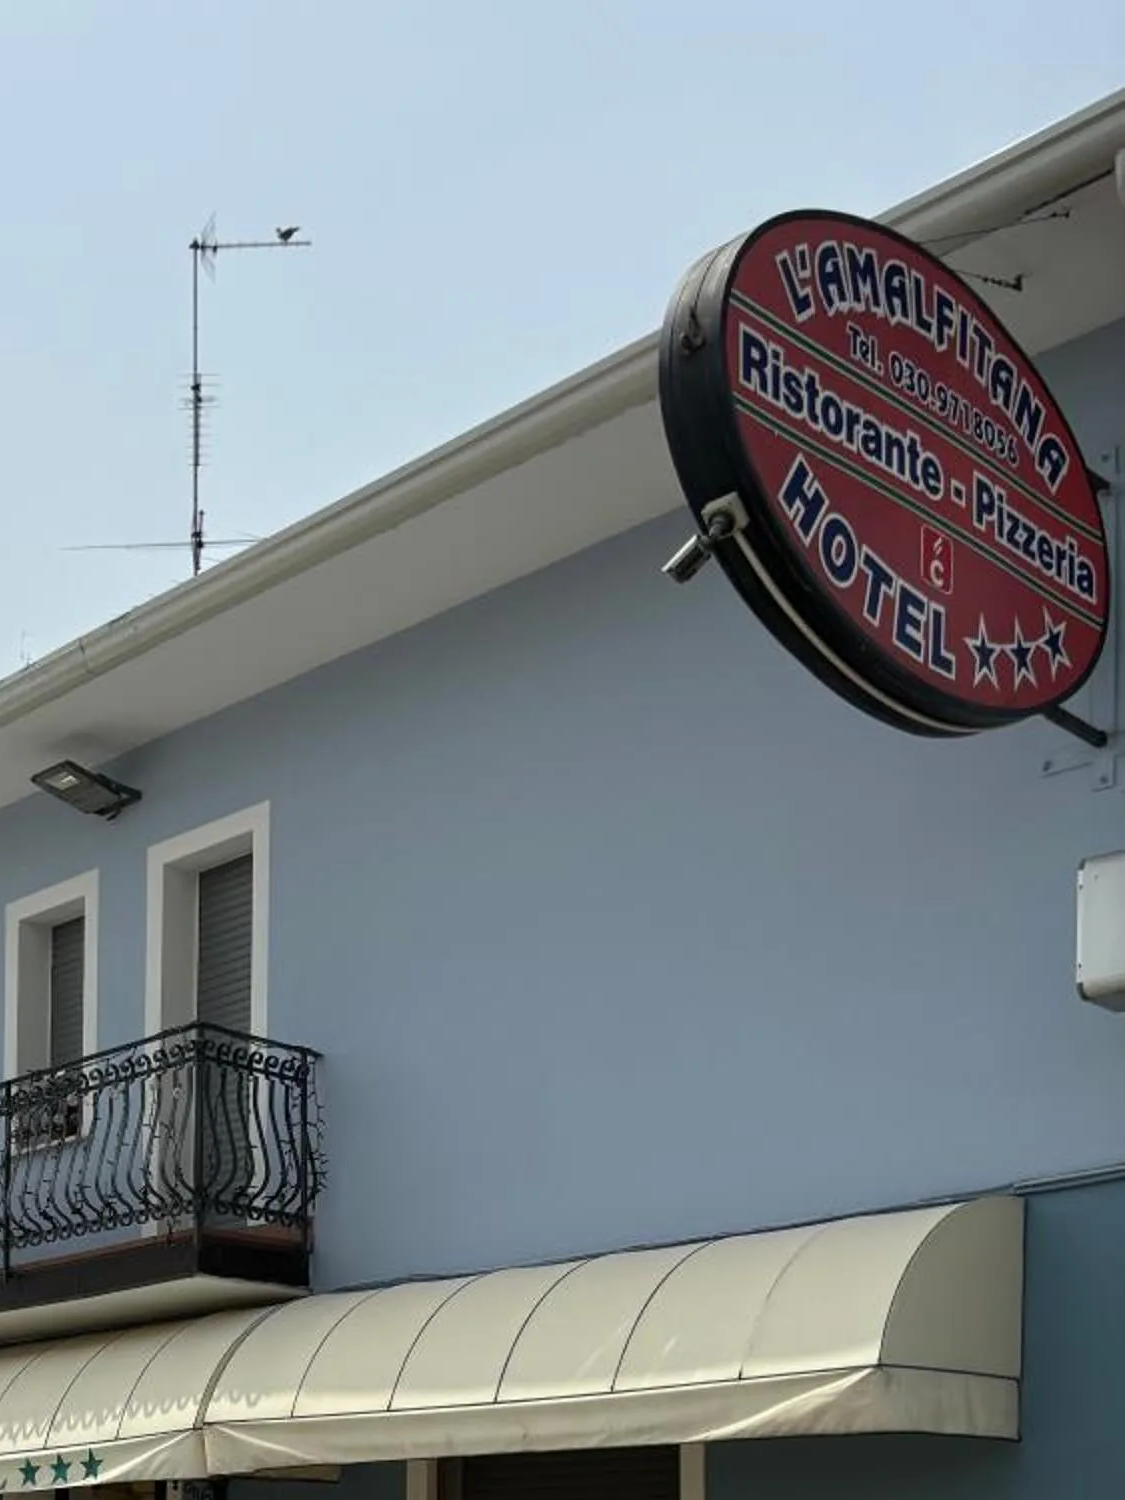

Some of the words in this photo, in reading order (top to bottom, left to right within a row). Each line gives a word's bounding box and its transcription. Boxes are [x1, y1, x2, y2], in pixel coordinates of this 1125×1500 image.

[739, 322, 945, 501] Ristorante
[973, 471, 1096, 604] Pizzeria
[776, 240, 1069, 493] L'AMALFITANA
[847, 322, 883, 376] Tel.
[778, 453, 956, 680] HOTEL
